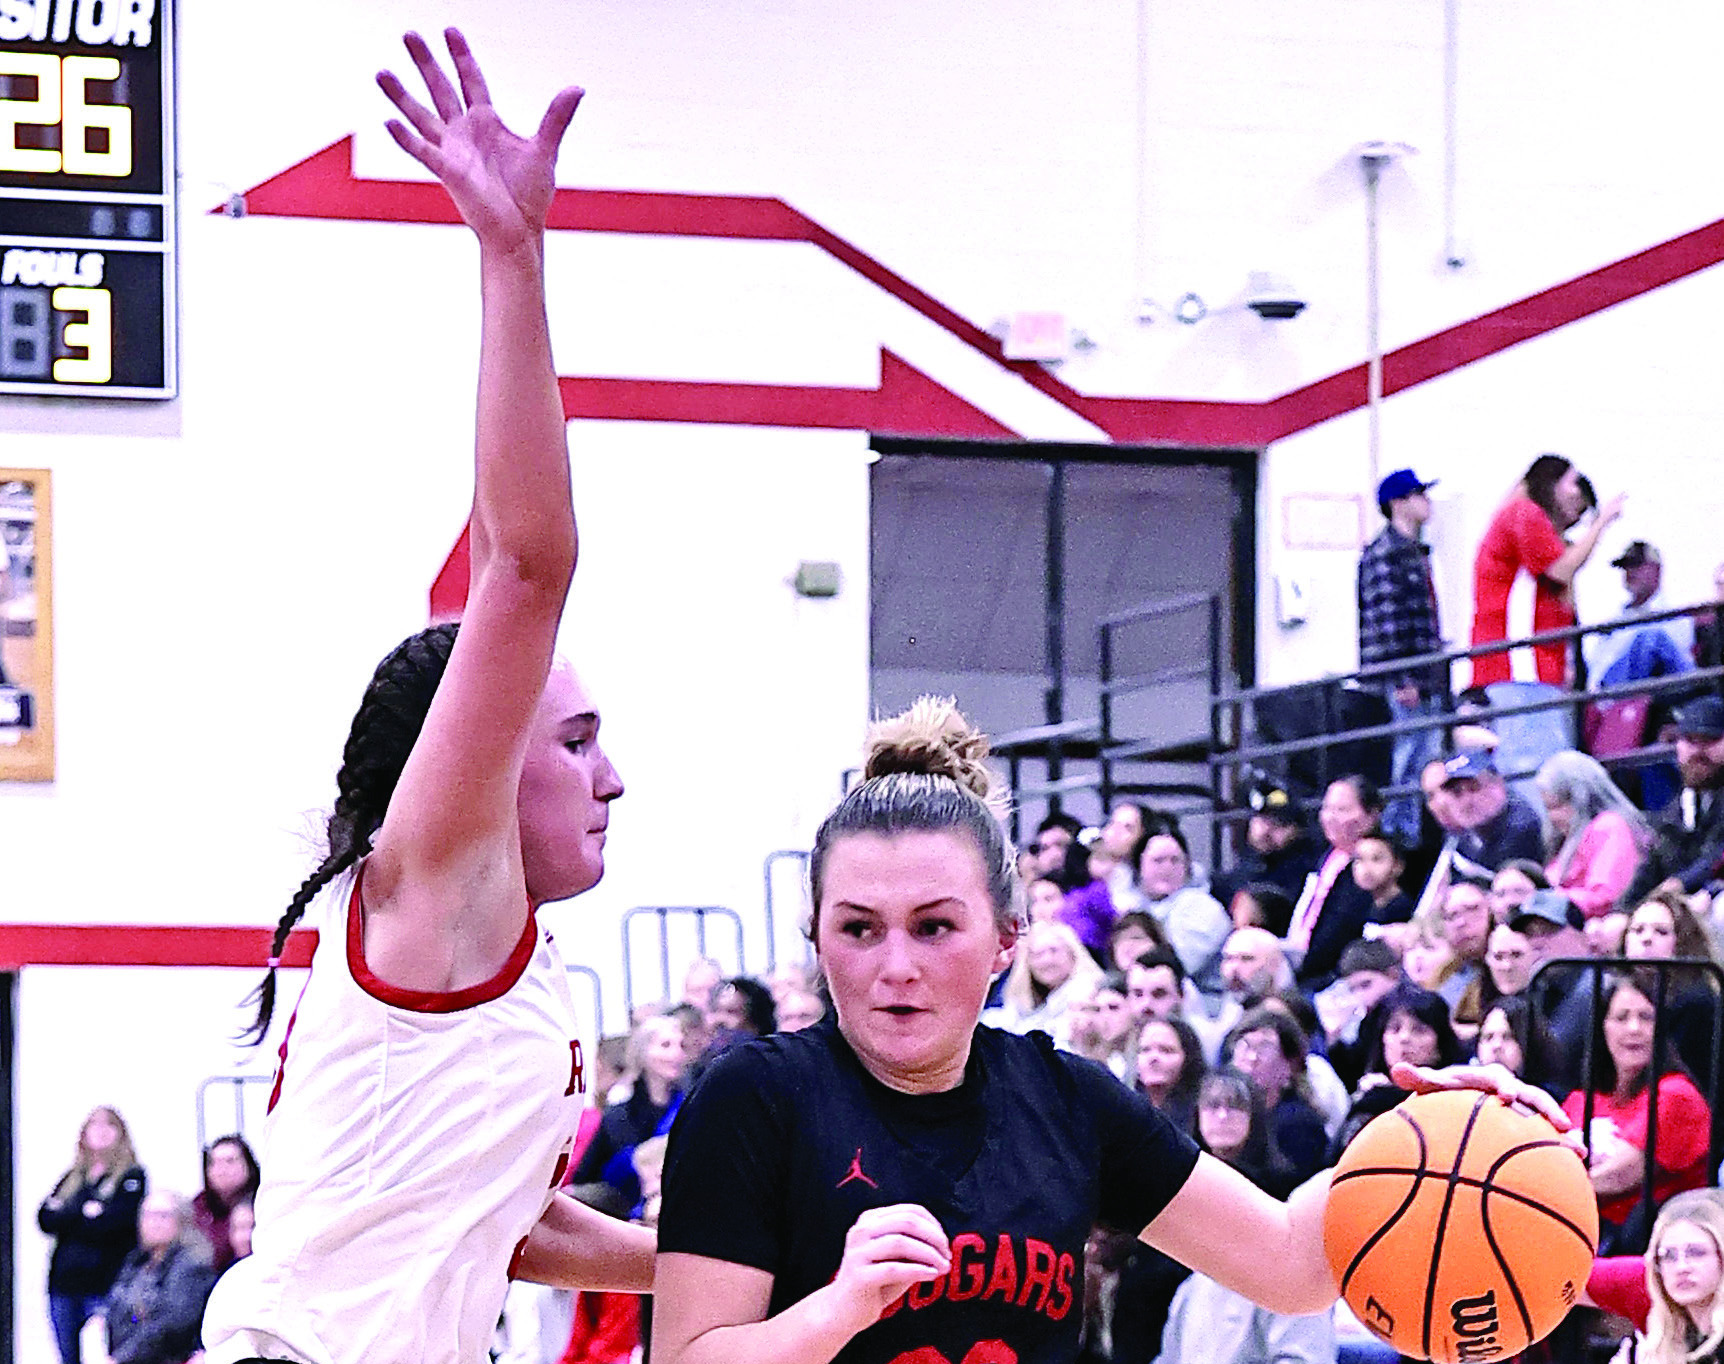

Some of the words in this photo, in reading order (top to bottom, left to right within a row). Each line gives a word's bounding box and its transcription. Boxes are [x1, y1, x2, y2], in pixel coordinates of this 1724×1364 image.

[0, 51, 133, 177] 26
[1, 248, 106, 287] FOULS
[53, 286, 112, 383] 3
